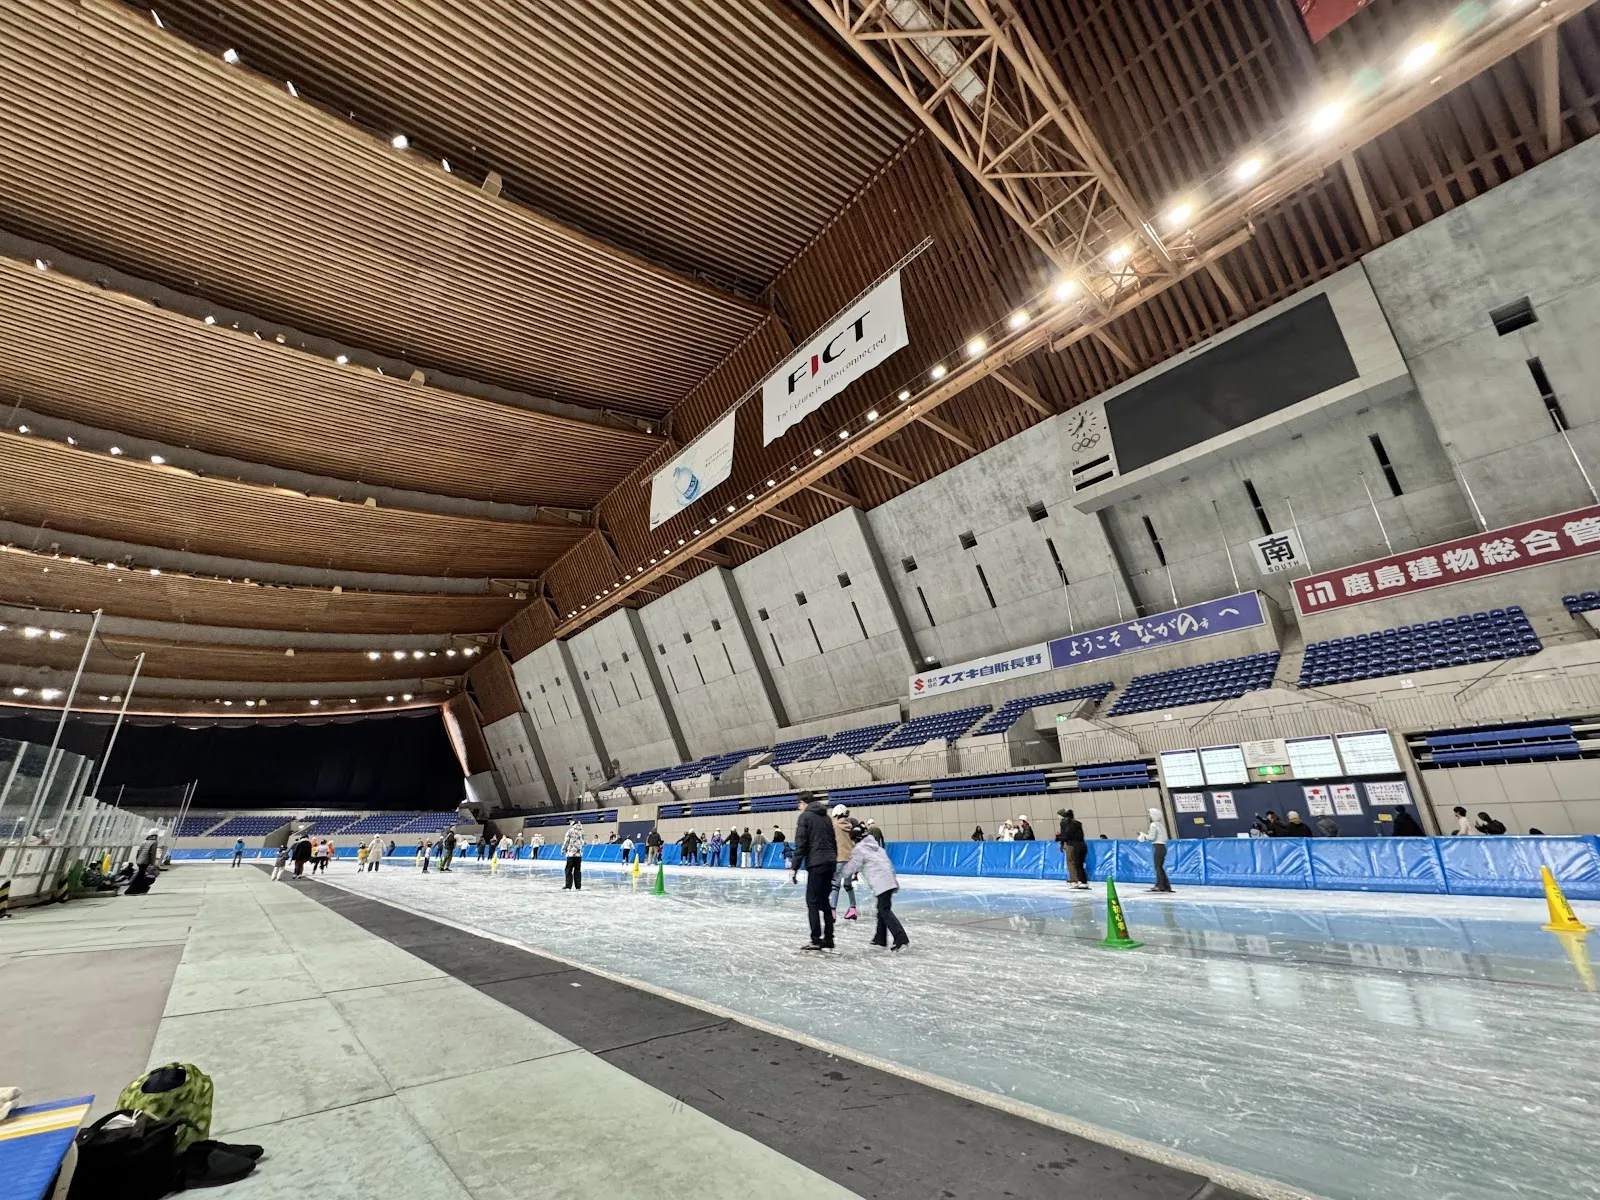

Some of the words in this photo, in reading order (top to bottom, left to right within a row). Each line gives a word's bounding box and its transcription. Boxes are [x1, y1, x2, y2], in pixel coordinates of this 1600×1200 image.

[788, 310, 871, 396] FICT
[789, 390, 815, 412] Future
[815, 384, 822, 394] is
[823, 333, 887, 387] Interconnected
[1258, 535, 1295, 566] 南
[1268, 560, 1300, 574] SOUTH
[1341, 517, 1600, 597] 鹿島建物総合管
[1069, 631, 1122, 657] ようこそ
[938, 652, 1043, 687] スズキ自販長野
